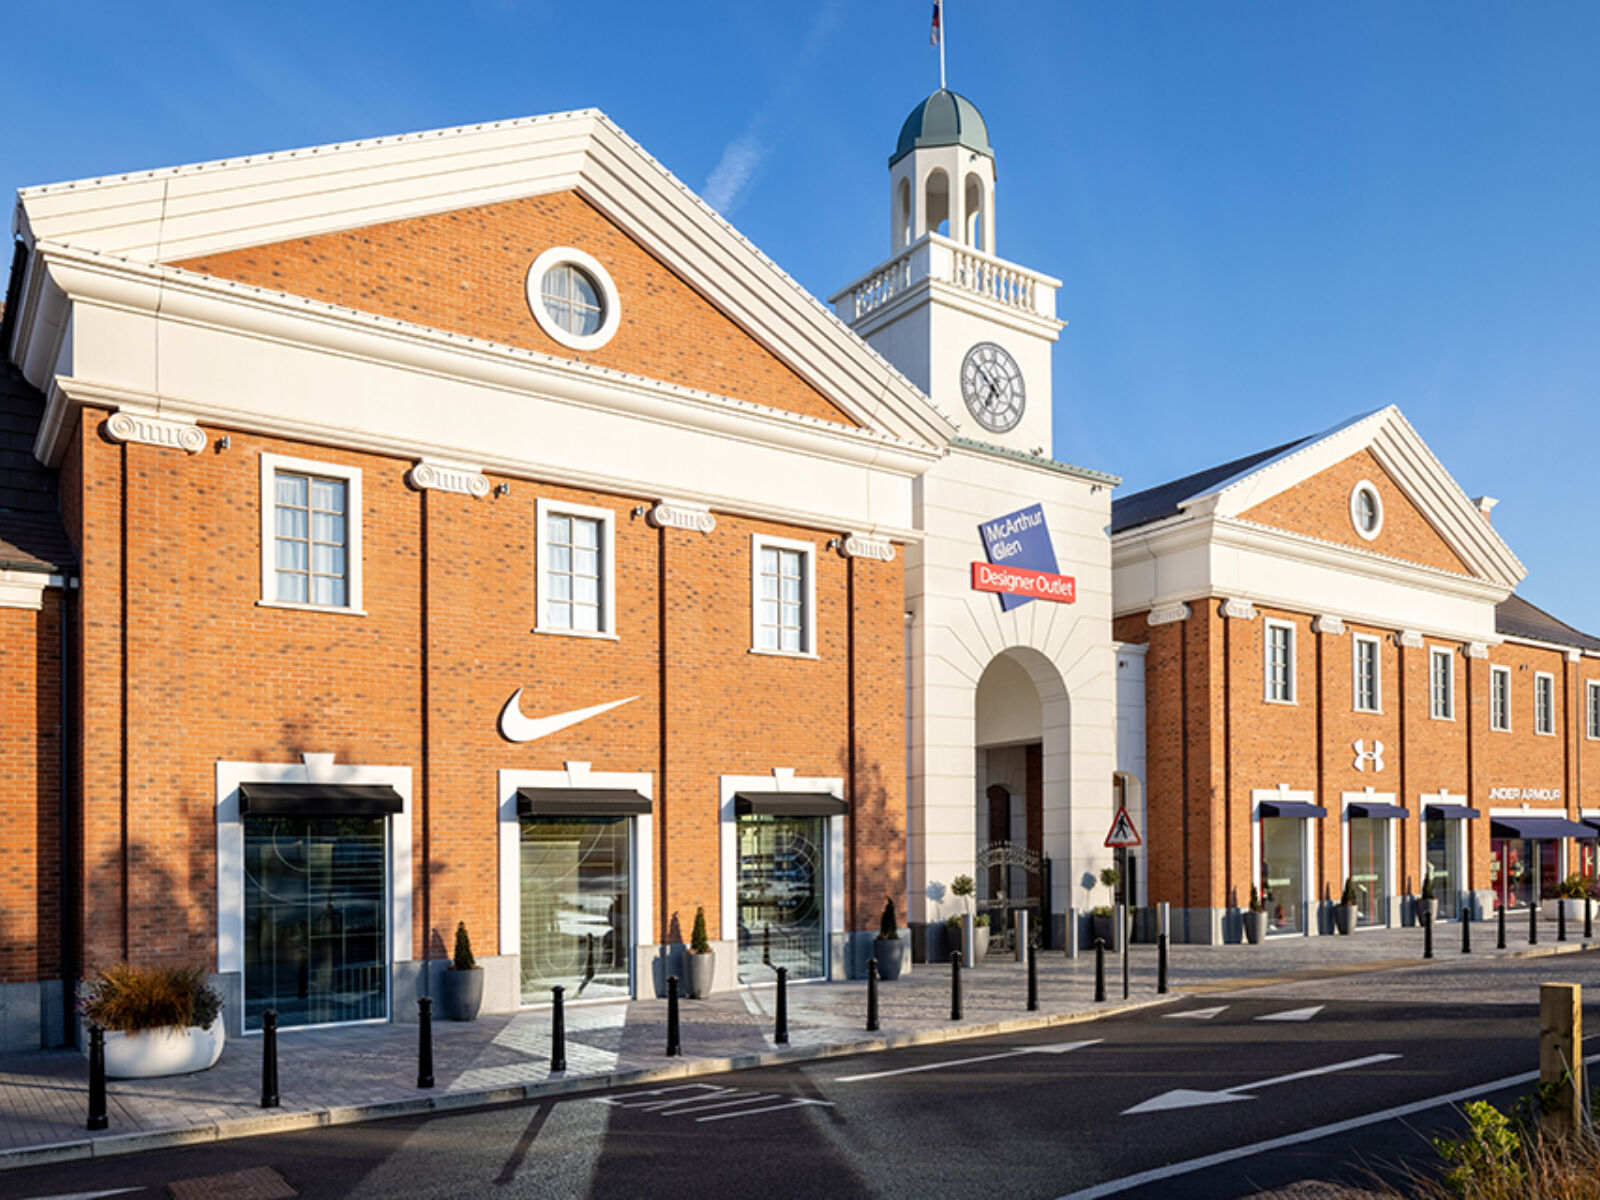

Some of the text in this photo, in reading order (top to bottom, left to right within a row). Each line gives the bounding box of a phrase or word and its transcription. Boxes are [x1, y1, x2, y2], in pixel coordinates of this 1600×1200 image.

[986, 511, 1042, 542] McArthur
[992, 540, 1022, 561] Glen
[980, 566, 1073, 597] Designer Outlet
[1521, 788, 1561, 801] ARMOUR
